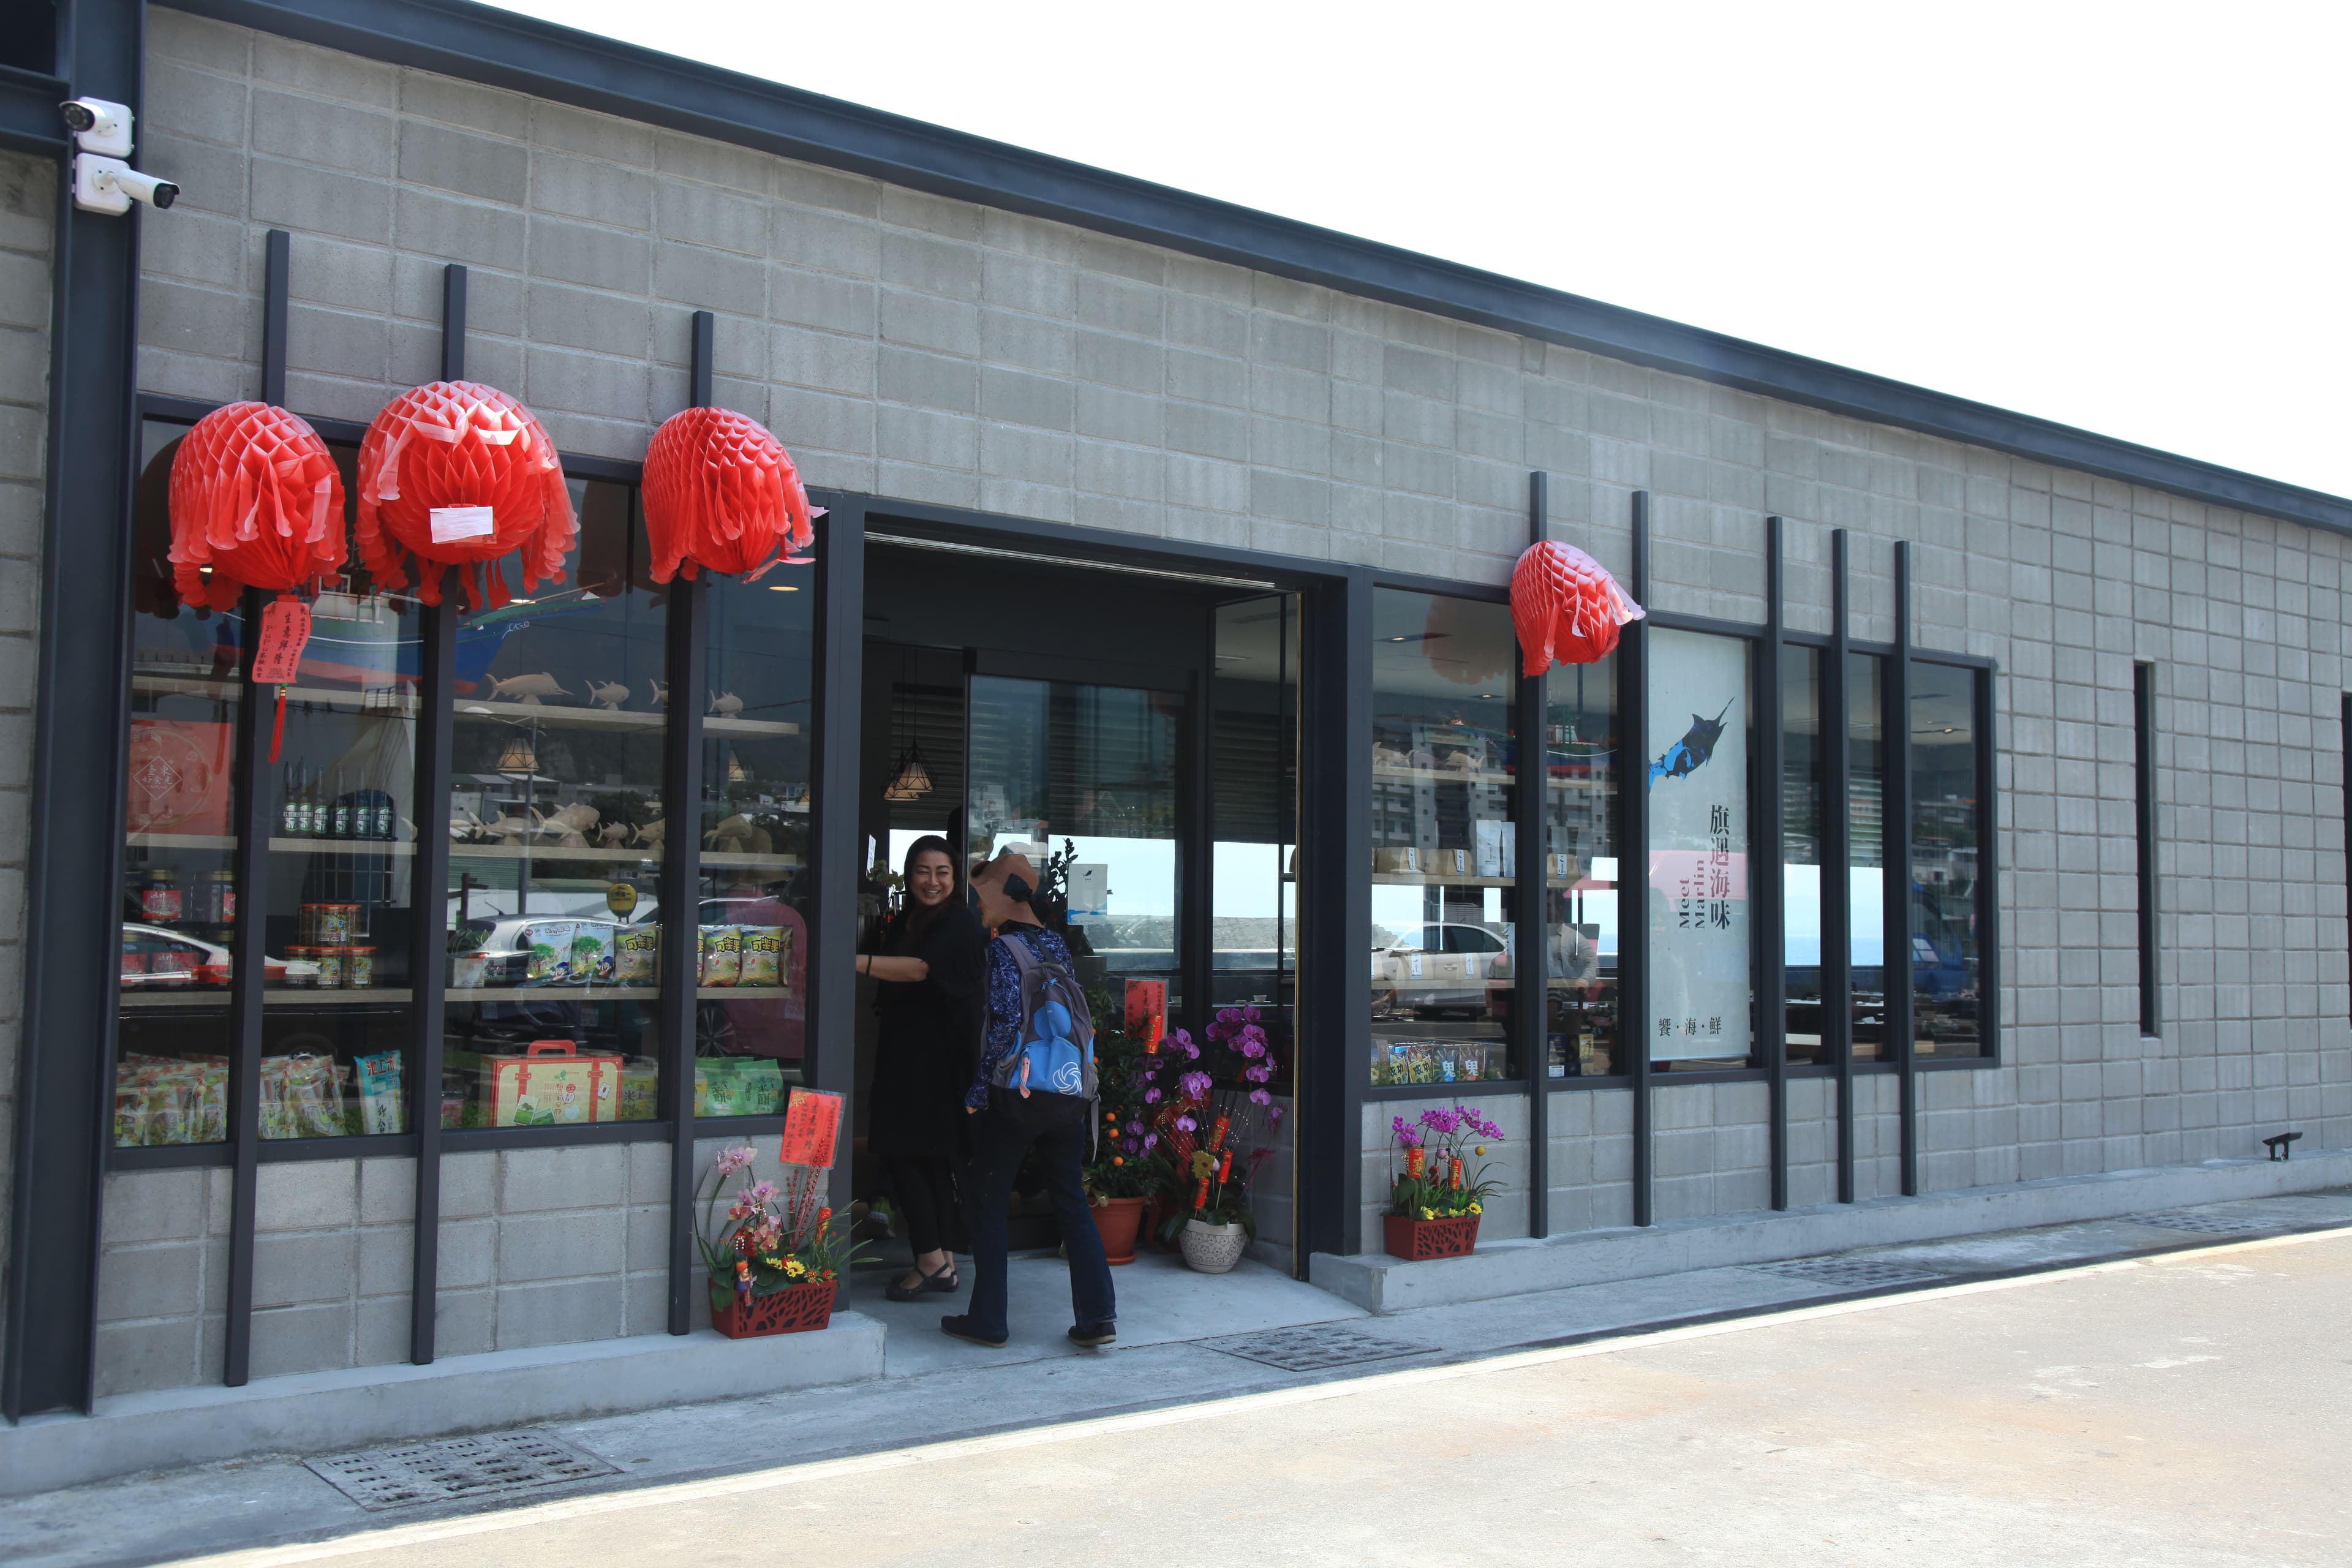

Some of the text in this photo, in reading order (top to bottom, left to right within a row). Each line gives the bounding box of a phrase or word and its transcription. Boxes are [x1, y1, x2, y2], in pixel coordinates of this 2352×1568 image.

[274, 611, 291, 665] 生意興隆
[1710, 805, 1730, 930] 旗遇海味
[1679, 878, 1690, 930] Meet
[1694, 860, 1705, 930] Marlin
[366, 1057, 396, 1076] 池上米
[1413, 1061, 1430, 1076] 成功
[1442, 1061, 1456, 1077] 鬼
[1465, 1060, 1479, 1076] 鬼
